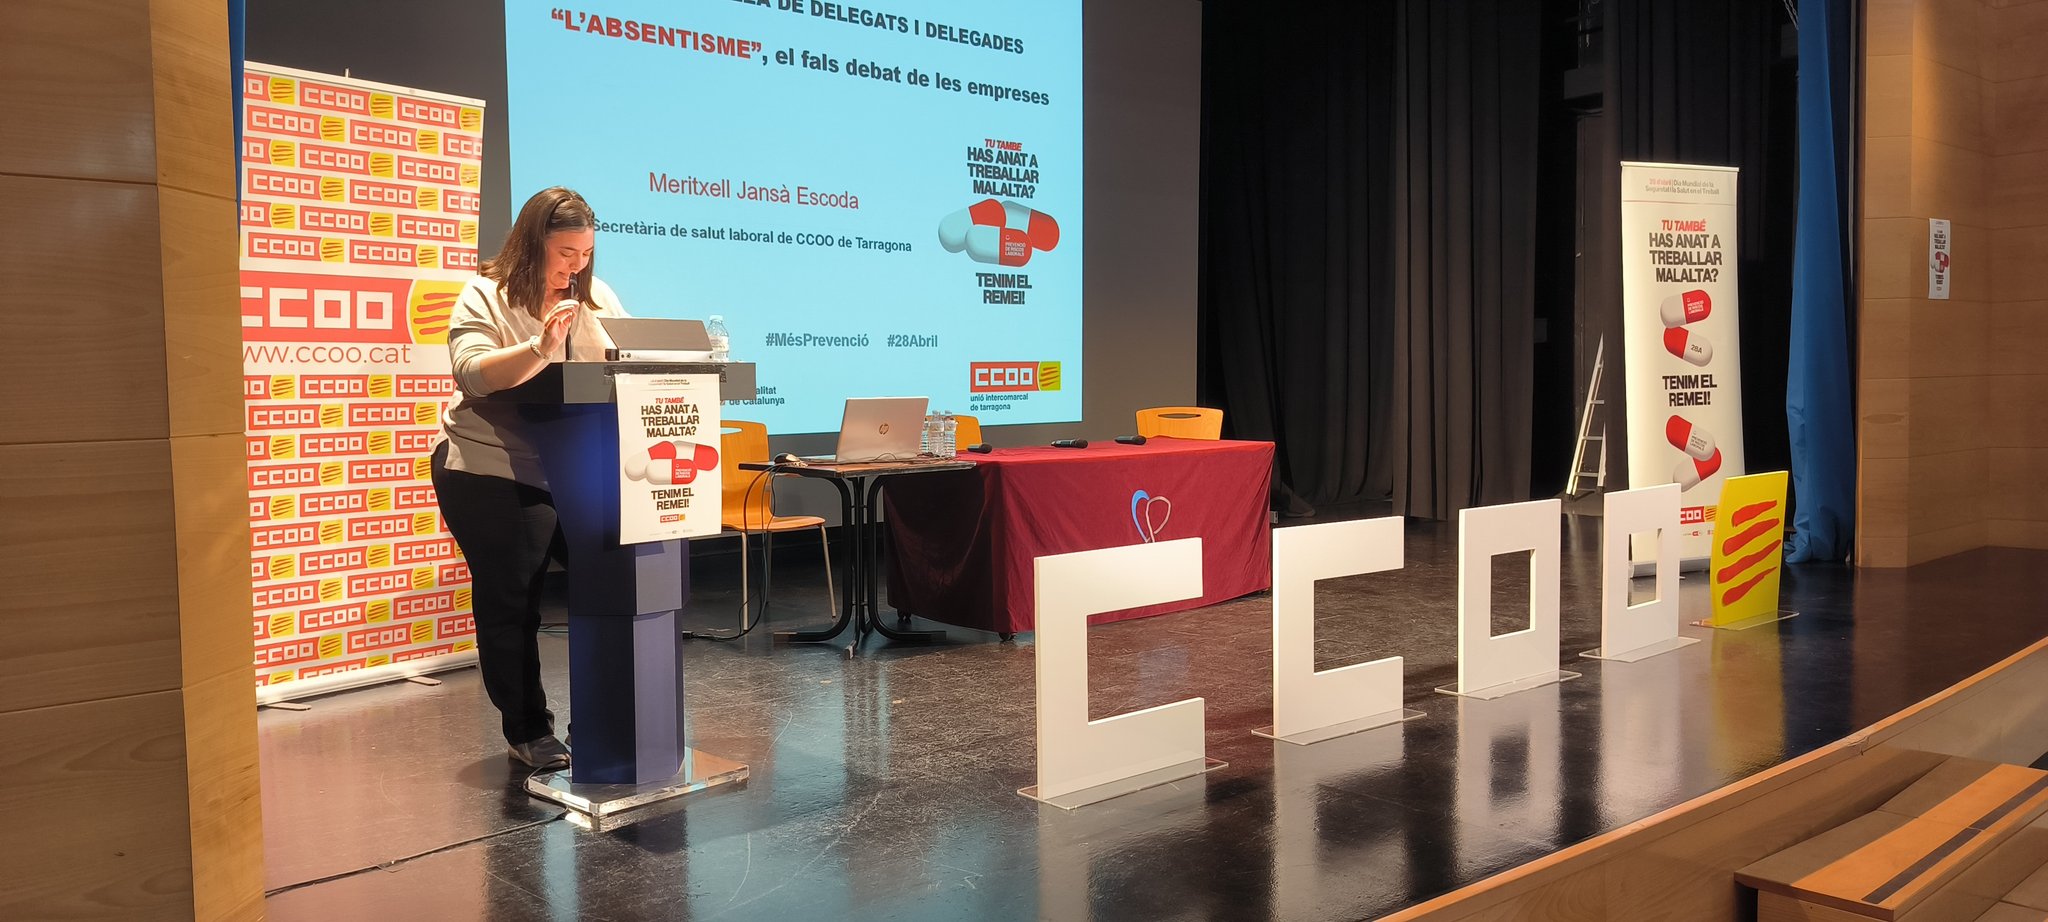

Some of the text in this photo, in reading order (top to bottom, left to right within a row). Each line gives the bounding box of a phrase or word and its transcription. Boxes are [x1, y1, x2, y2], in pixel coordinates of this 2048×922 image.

[811, 0, 909, 33] DELEGATS
[914, 19, 920, 35] I
[925, 22, 1024, 54] DELEGADES
[775, 48, 795, 66] el
[801, 50, 839, 73] fals
[846, 59, 901, 83] debat
[907, 69, 930, 87] de
[936, 72, 962, 92] les
[967, 81, 1050, 106] empreses
[305, 88, 364, 110] CCOO
[402, 103, 455, 124] CCOO
[252, 112, 314, 133] CCOO
[354, 126, 412, 146] CCOO
[984, 138, 996, 148] TU
[447, 138, 481, 156] CCO
[305, 150, 364, 170] CCOO
[967, 146, 1039, 168] HAS ANAT A
[402, 161, 455, 180] CCOO
[967, 162, 1039, 184] TREBALLAR
[253, 174, 314, 194] CCOO
[649, 172, 859, 210] Meritxell Jansà Escoda
[973, 180, 1036, 199] MALALTA?
[354, 185, 412, 204] CCOO
[447, 194, 480, 211] CCO
[305, 212, 364, 230] CCOO
[402, 220, 455, 238] CCOO
[1662, 218, 1706, 231] TU TAMBÉ
[593, 218, 912, 253] Secretària de salut laboral de CCOO de Tarragona
[1649, 232, 1721, 248] HAS ANAT A
[254, 238, 314, 256] CCOO
[354, 245, 412, 262] CCOO
[446, 252, 478, 267] CCO
[1649, 250, 1722, 265] TREBALLAR
[975, 272, 1032, 289] TENIM EL
[1656, 267, 1719, 283] MALALTA?
[983, 289, 1025, 305] REMEI!
[765, 333, 938, 348] #MésPrevenció #28Abril
[1690, 344, 1702, 354] 28A
[243, 345, 411, 364] ww.ccoo.cat
[975, 368, 1033, 386] CCOO
[1662, 374, 1717, 390] TENIM EL
[305, 380, 362, 394] CCOO
[400, 379, 454, 393] CCOO
[970, 393, 1029, 402] unió intercomarcal
[1669, 391, 1711, 407] REMEI!
[353, 408, 410, 422] CCOO
[641, 404, 699, 415] HAS ANAT A
[980, 404, 1011, 412] tarragona
[254, 410, 314, 425] CCOO
[641, 415, 699, 426] TREBALLAR
[646, 426, 697, 438] MALALTA?
[305, 437, 362, 453] CCOO
[400, 434, 435, 449] CC
[254, 468, 314, 486] CCOO
[353, 463, 408, 479] CCOO
[399, 490, 437, 505] CCO
[651, 487, 694, 500] TENIM EL
[305, 495, 362, 512] CCOO
[656, 498, 690, 510] REMEI!
[352, 519, 408, 536] CCOO
[254, 527, 314, 546] CCOO
[398, 542, 451, 560] CCOO
[304, 552, 362, 571] CCOO
[442, 566, 472, 582] CC
[352, 574, 407, 594] CCOO
[253, 586, 314, 606] CCOO
[398, 595, 450, 616] CCOO
[304, 608, 361, 628] CCOO
[442, 617, 476, 634] CCO
[352, 629, 406, 649] CCOO
[1034, 484, 1681, 799] CCOO
